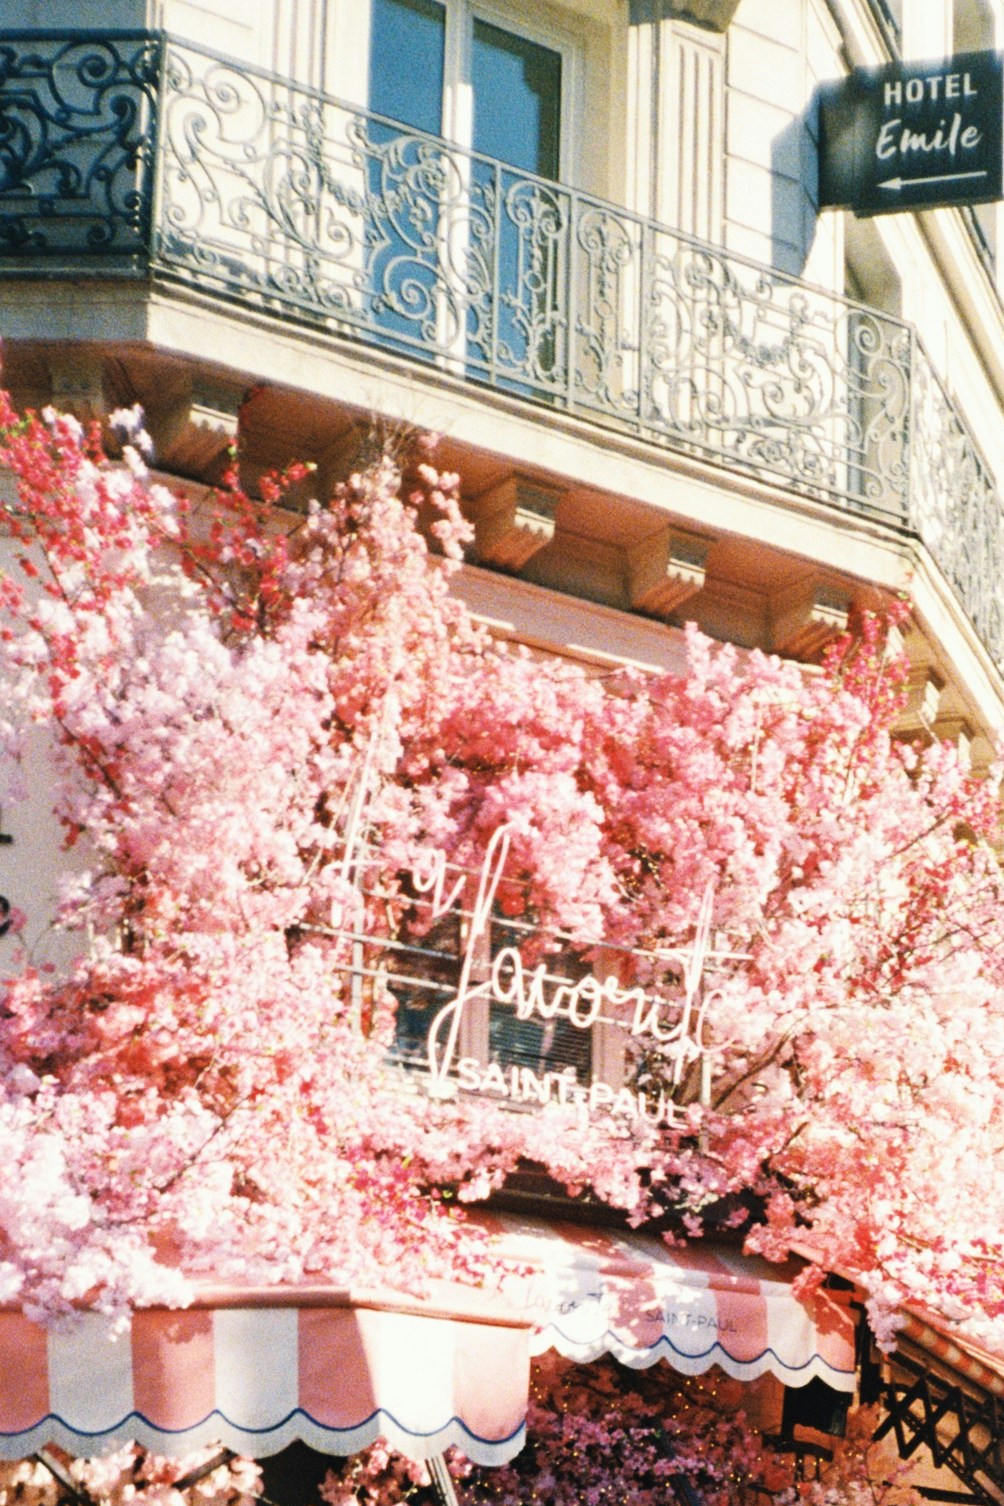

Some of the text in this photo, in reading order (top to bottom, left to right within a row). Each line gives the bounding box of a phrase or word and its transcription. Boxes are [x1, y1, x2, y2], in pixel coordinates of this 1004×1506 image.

[883, 72, 978, 106] HOTEL
[875, 112, 983, 160] Emile
[456, 1056, 690, 1131] SAINT-PAUL
[645, 1308, 737, 1333] SAINT-PAUL
